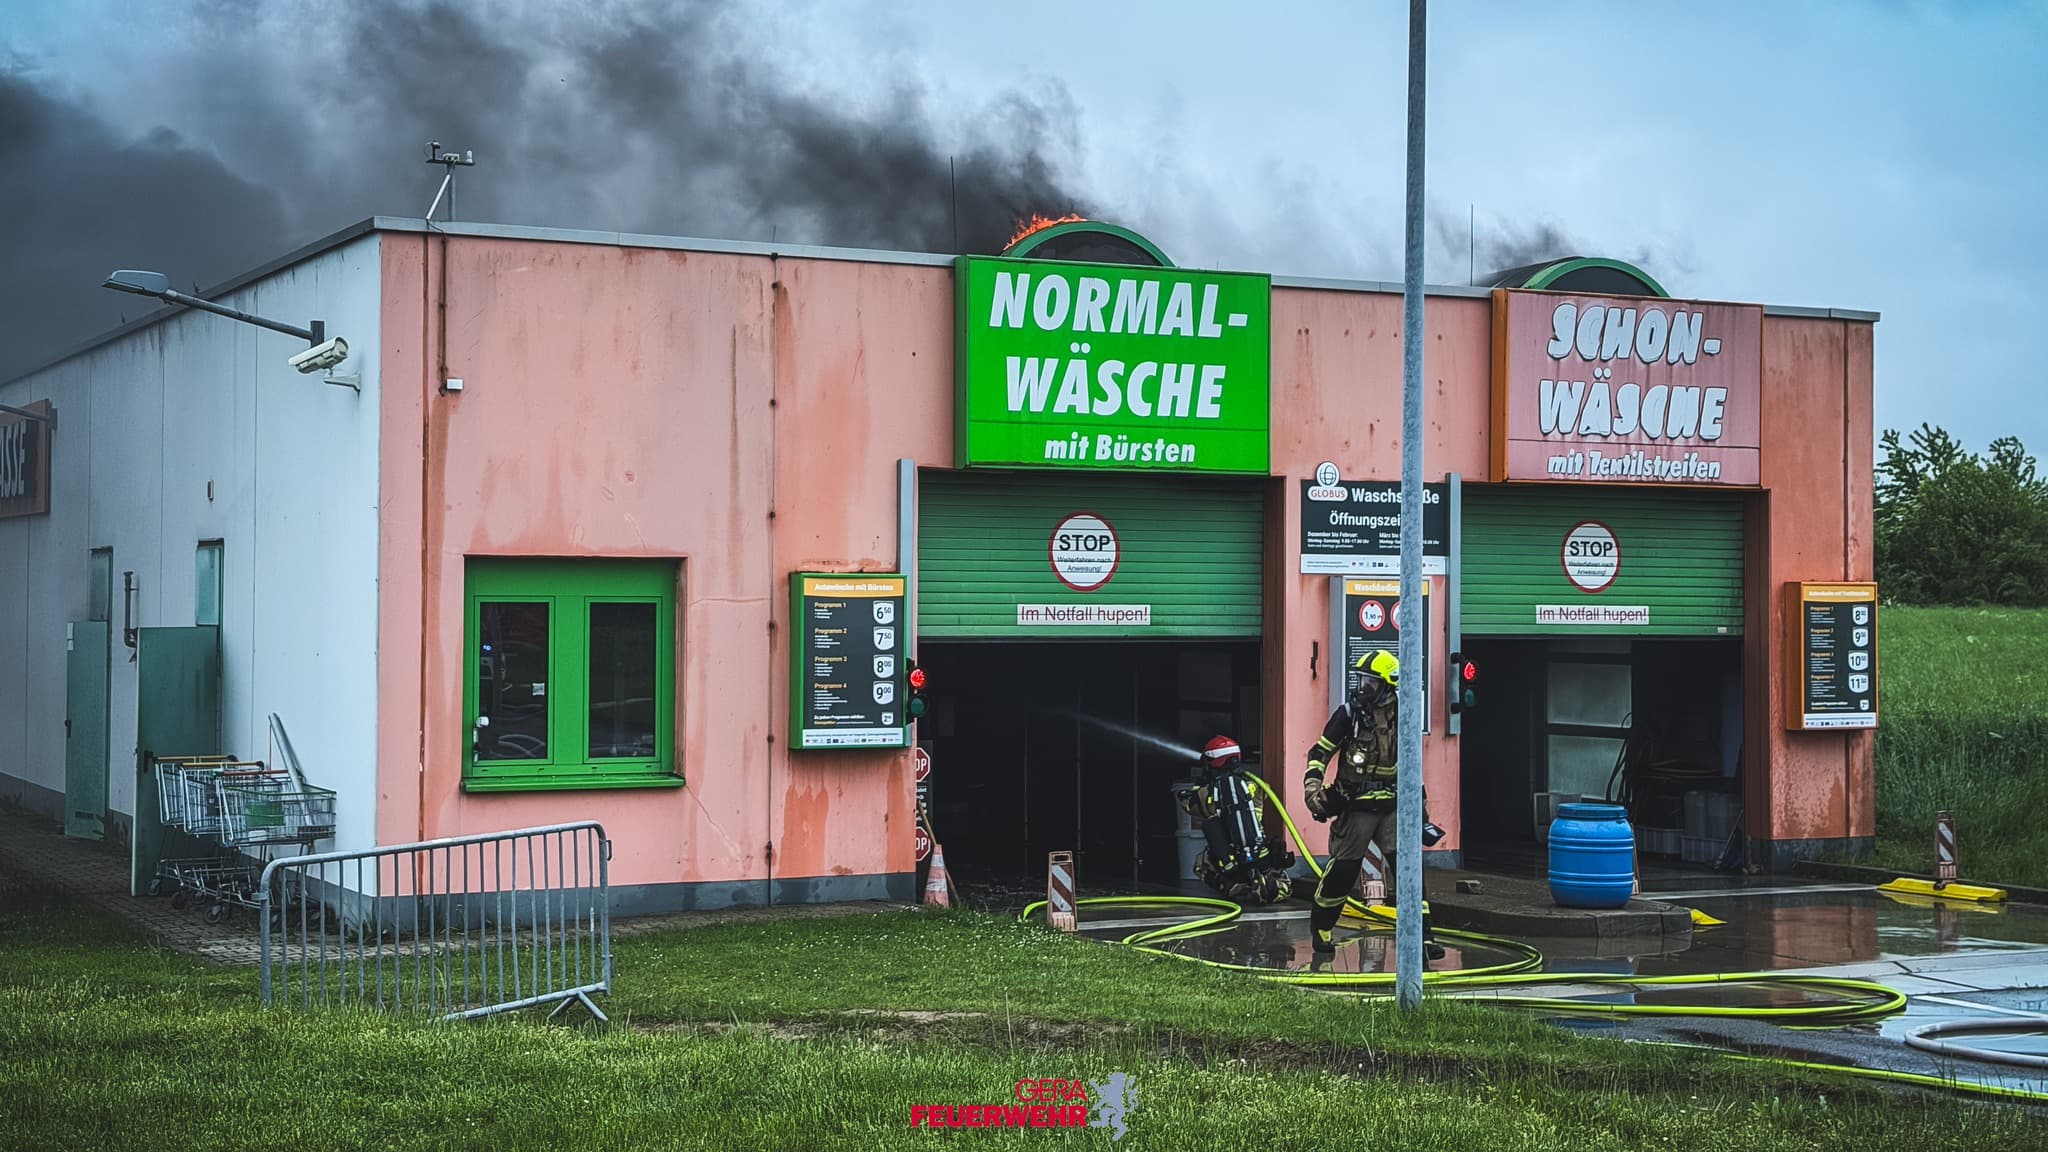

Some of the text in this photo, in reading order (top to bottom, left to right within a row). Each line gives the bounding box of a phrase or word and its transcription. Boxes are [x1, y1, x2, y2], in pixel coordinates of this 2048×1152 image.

[989, 272, 1248, 338] NORMAL-
[1547, 303, 1722, 364] SCHON-
[1006, 342, 1226, 419] WÄSCHE
[1539, 367, 1728, 440] WÄSCHE
[1044, 432, 1196, 463] mit Bürsten
[1547, 449, 1721, 479] mit Textilstreifen
[1310, 489, 1346, 498] GLOBUS
[1351, 488, 1441, 504] Waschsße
[1059, 534, 1110, 551] STOP
[1569, 541, 1613, 557] STOP
[1021, 606, 1148, 624] Im Notfall hupen!
[1539, 607, 1647, 623] Im Notfall hupen!
